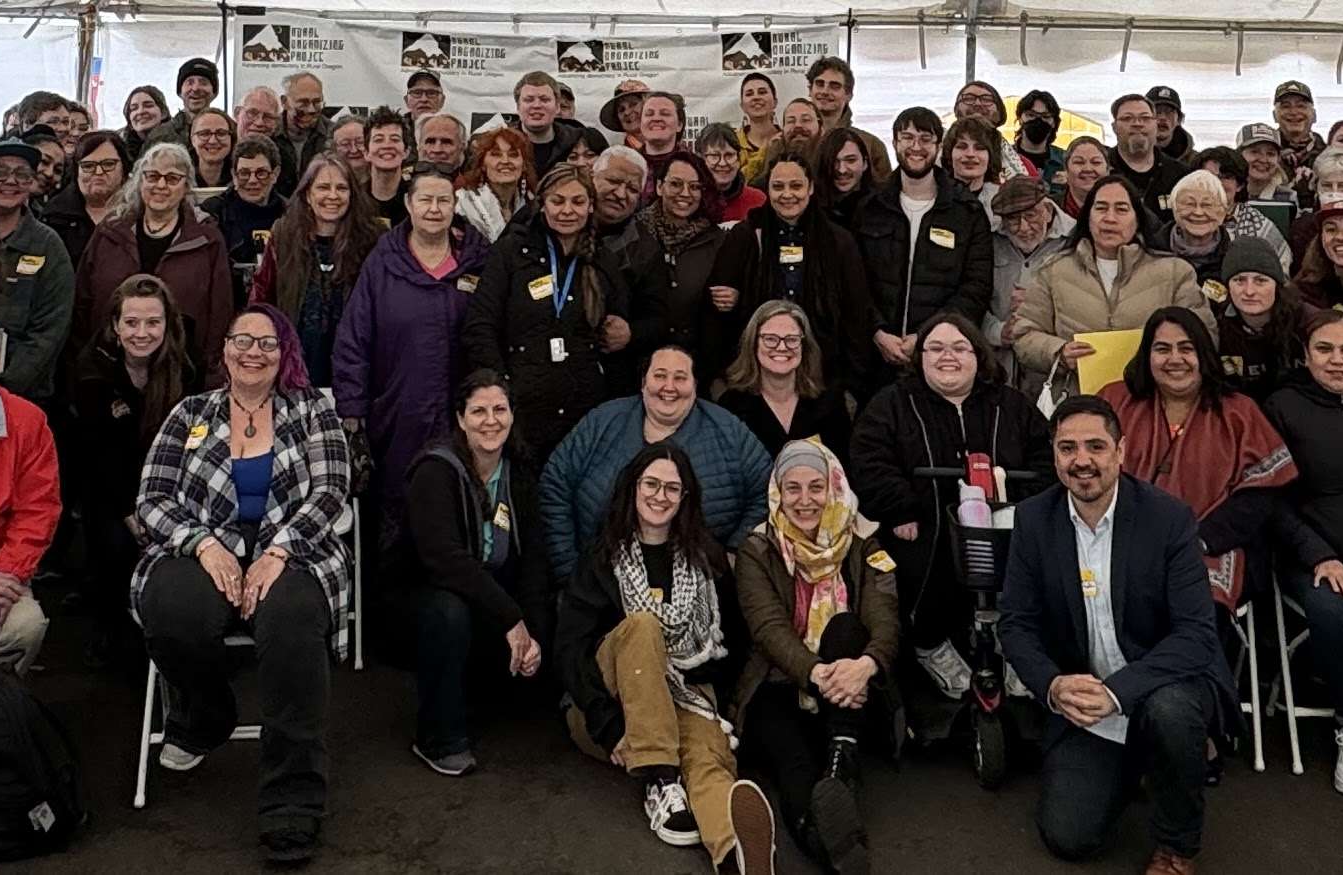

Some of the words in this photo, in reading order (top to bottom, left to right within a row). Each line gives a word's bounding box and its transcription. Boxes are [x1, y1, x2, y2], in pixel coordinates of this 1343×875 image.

[291, 28, 320, 38] RURAL
[772, 31, 803, 42] RURAL
[291, 39, 344, 51] ORGANIZING
[772, 43, 829, 55] ORGANIZING
[451, 46, 506, 58] ORGANIZING
[604, 50, 659, 60] ORGANIZING
